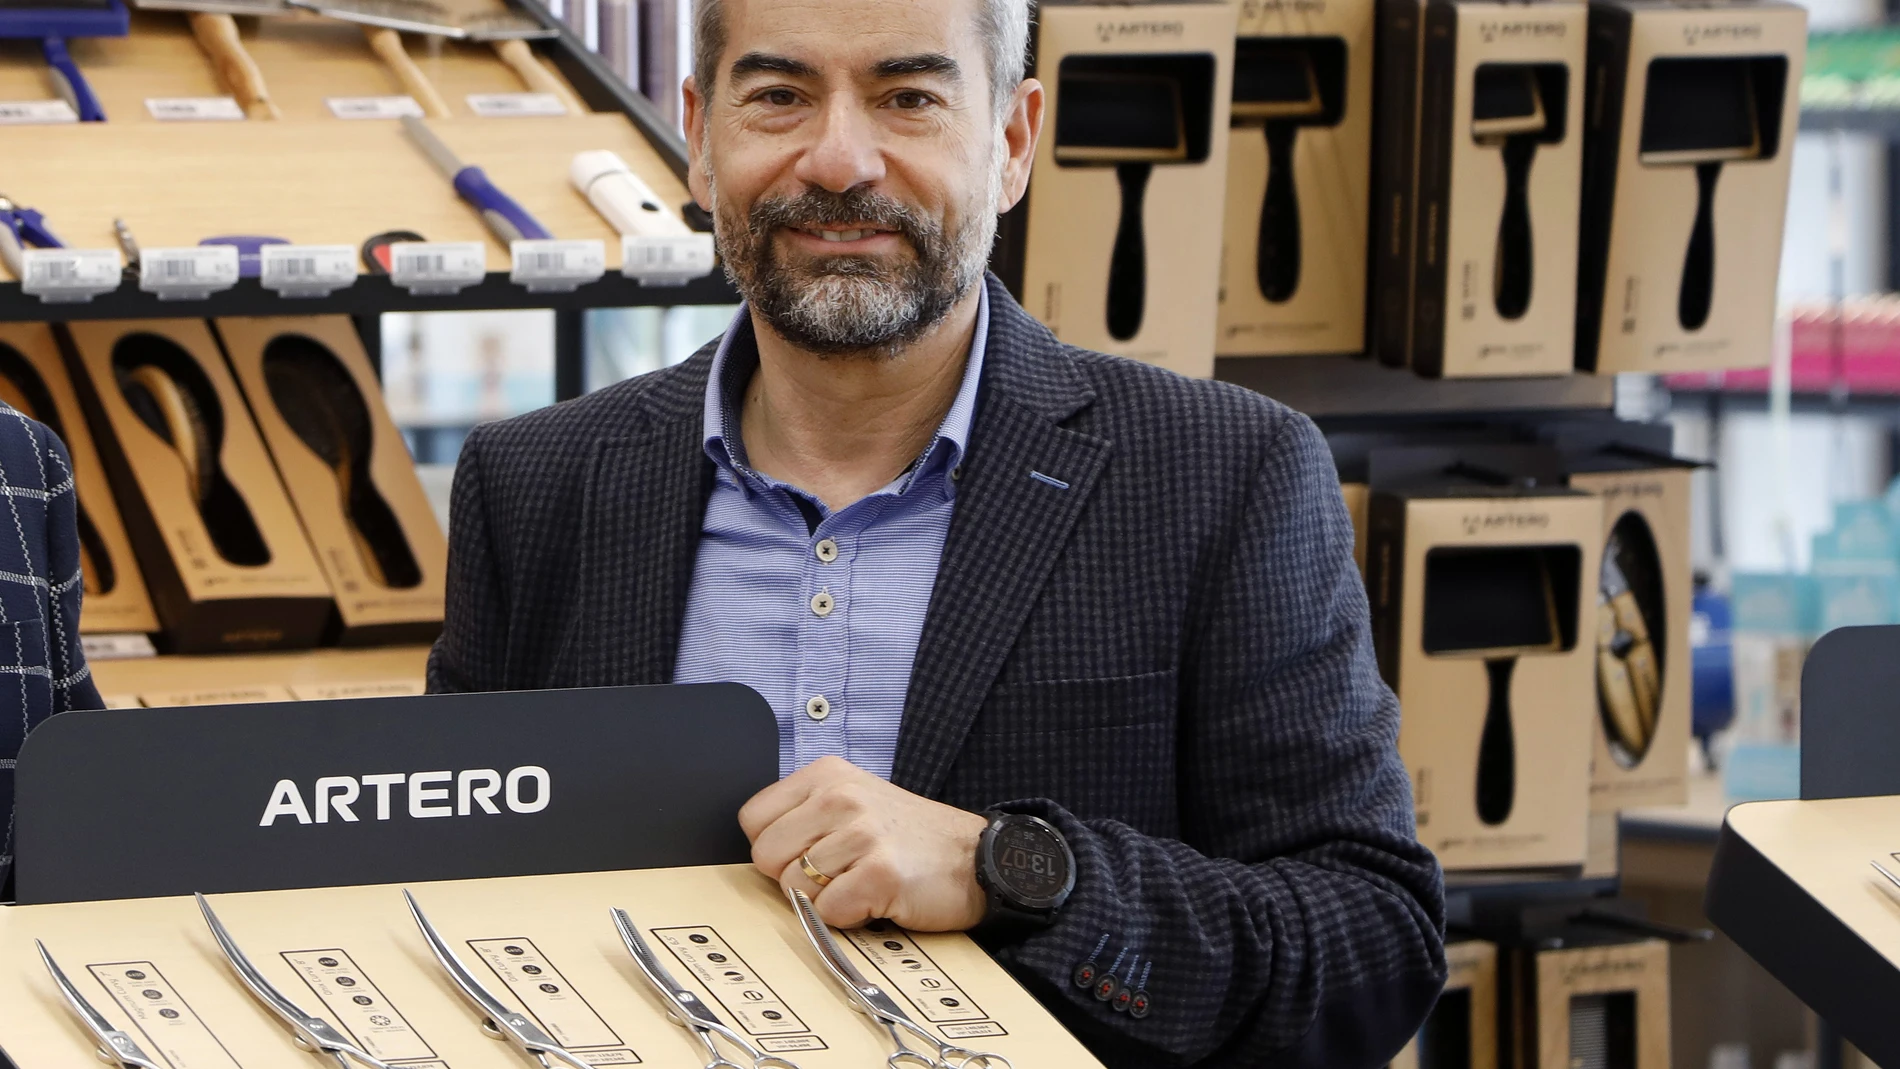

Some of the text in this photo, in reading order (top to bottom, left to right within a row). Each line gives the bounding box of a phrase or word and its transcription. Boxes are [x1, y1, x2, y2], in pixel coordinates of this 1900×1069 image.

[259, 766, 551, 827] ARTERO
[1001, 847, 1056, 877] 13:07
[678, 946, 696, 965] Curvy
